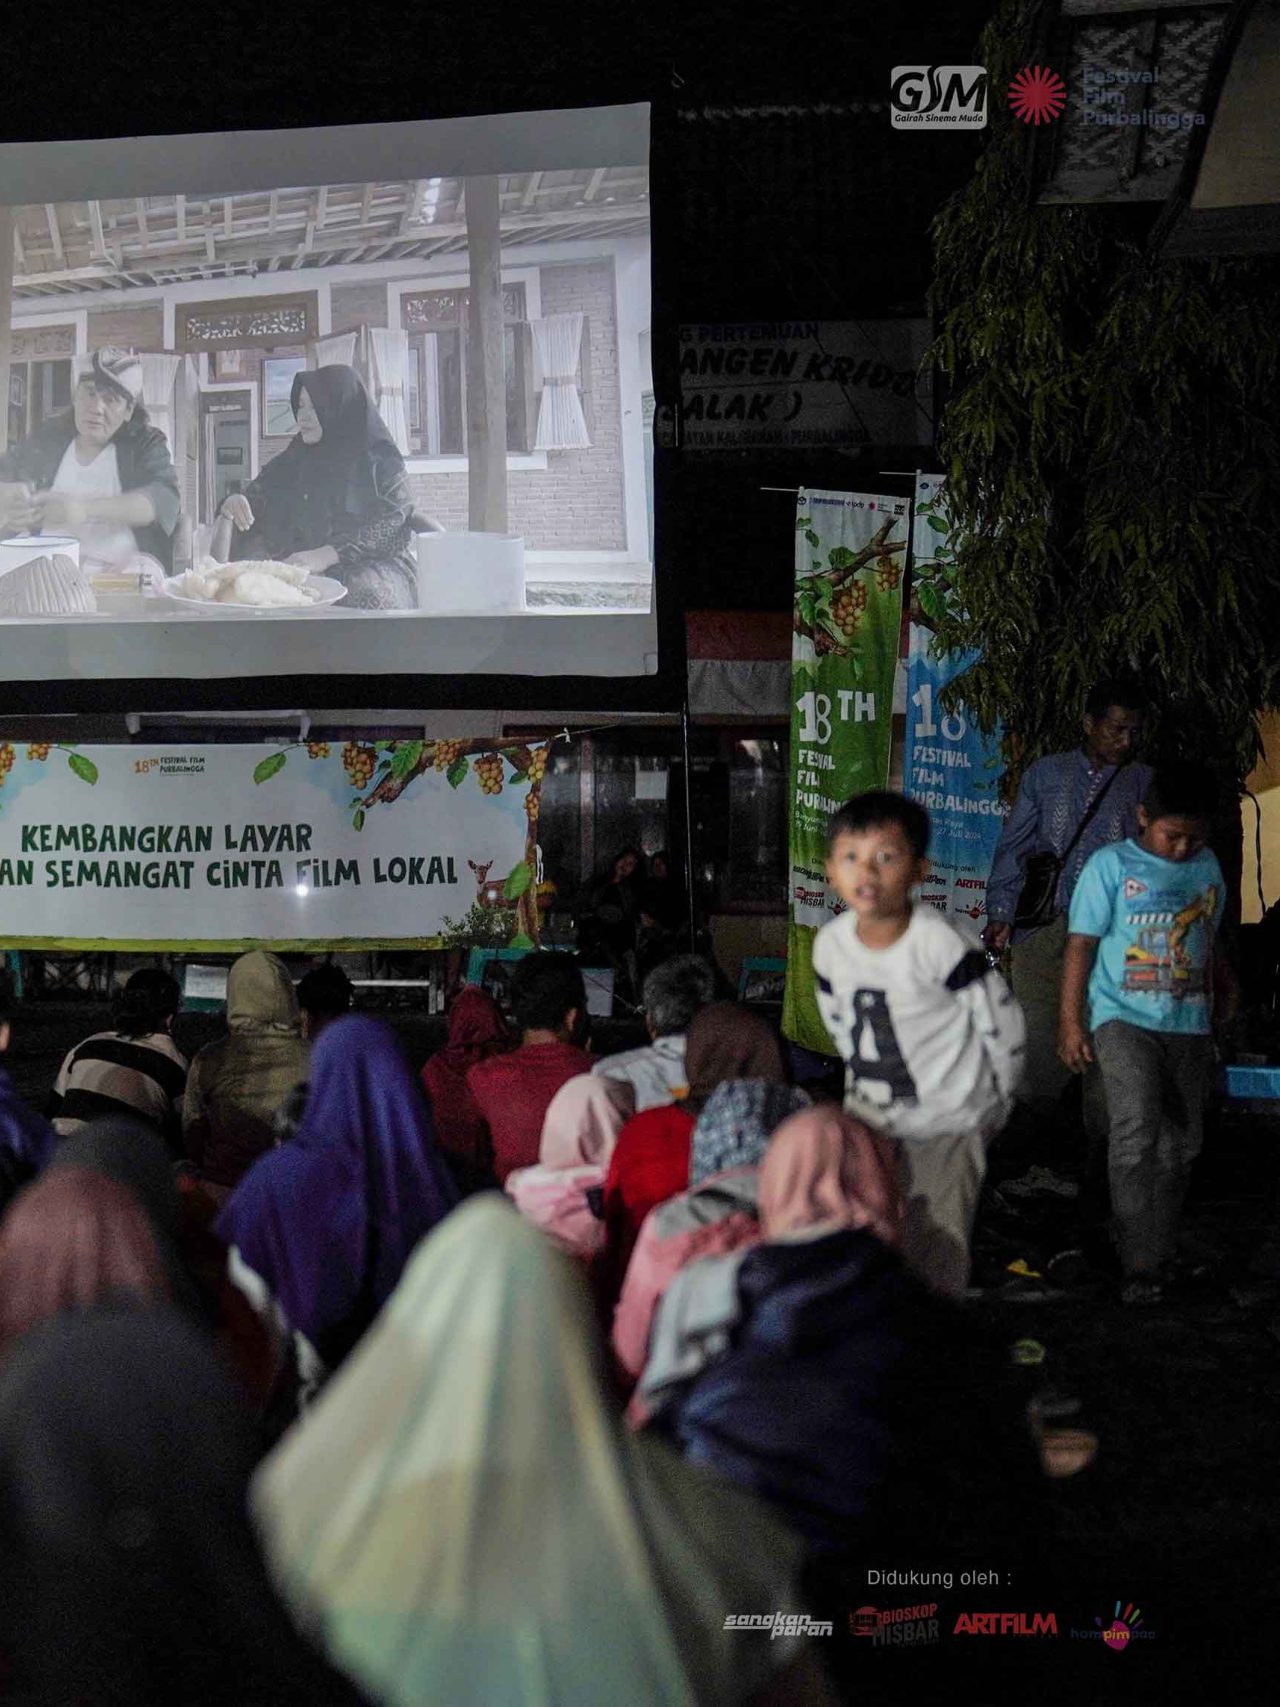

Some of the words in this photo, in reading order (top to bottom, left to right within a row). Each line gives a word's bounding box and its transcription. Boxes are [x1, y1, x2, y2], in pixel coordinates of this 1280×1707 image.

[795, 690, 876, 745] 18TH
[135, 758, 159, 773] 18TH
[913, 745, 971, 768] FESTIVAL
[161, 765, 205, 773] PURBALINGGA
[912, 767, 944, 787] FILM
[21, 824, 213, 852] KEMBANGKAN
[225, 824, 312, 852] LAYAR
[45, 860, 194, 889] SEMANGAT
[373, 856, 458, 885] LOKAL
[955, 878, 988, 889] ARTFIL
